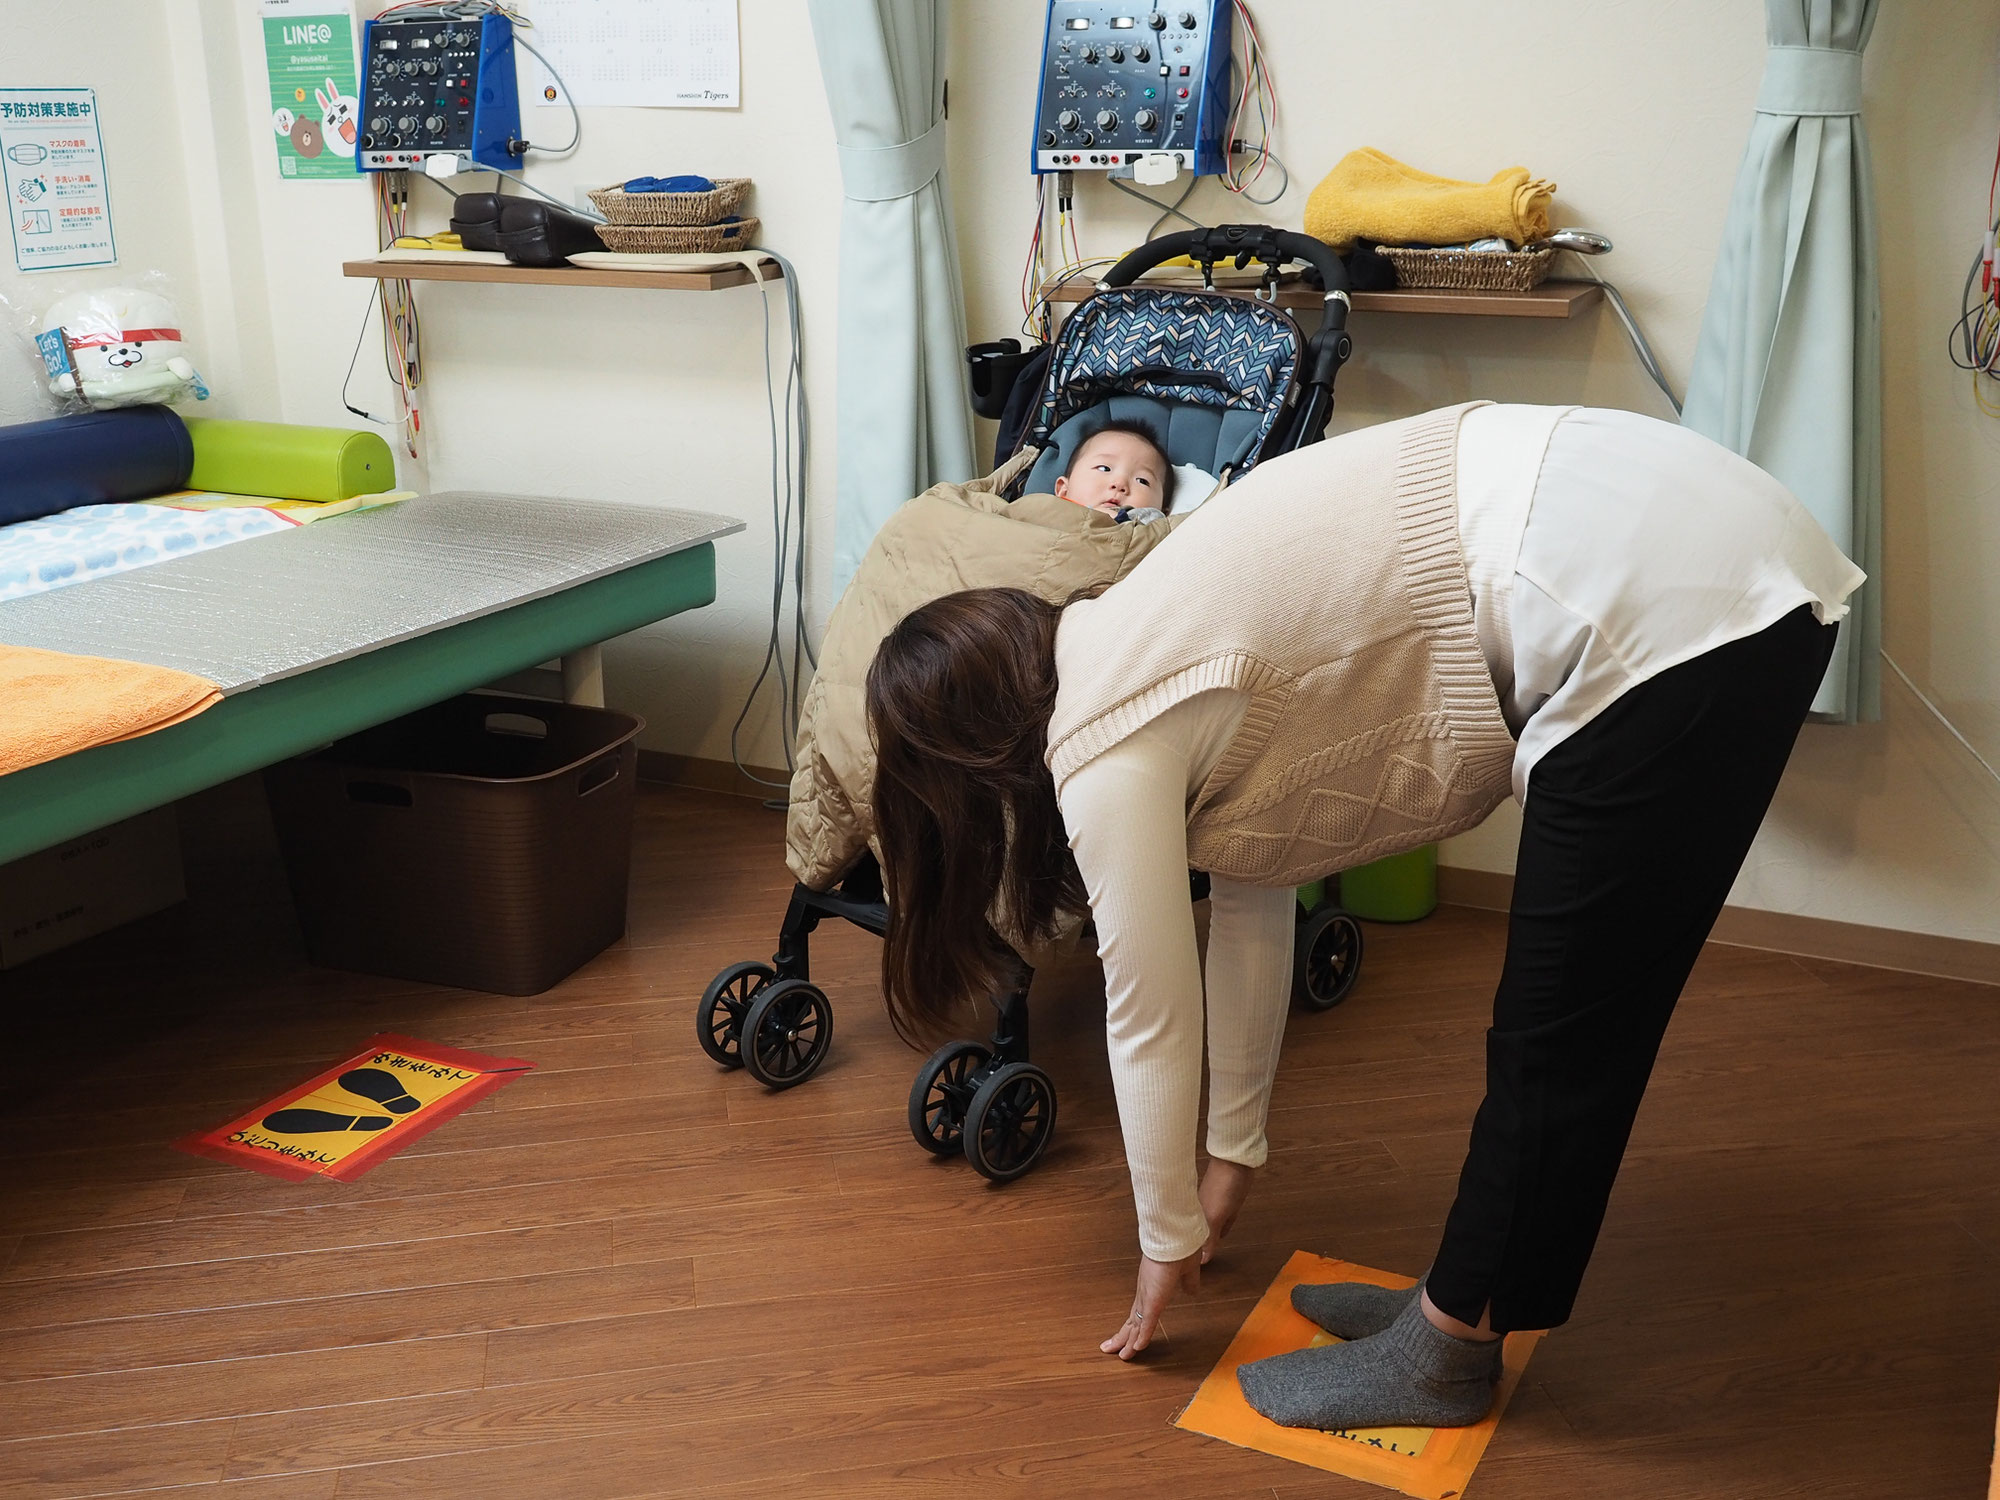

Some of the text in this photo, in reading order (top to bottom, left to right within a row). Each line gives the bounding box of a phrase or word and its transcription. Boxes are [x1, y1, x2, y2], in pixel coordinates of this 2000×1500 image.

[283, 24, 332, 45] LINE@
[703, 90, 729, 101] Tigers
[0, 102, 91, 118] 予防対策実施中
[49, 139, 86, 148] マスクの着用
[59, 207, 101, 217] 定期的な換気
[38, 334, 58, 352] Let's
[45, 351, 62, 373] Go!
